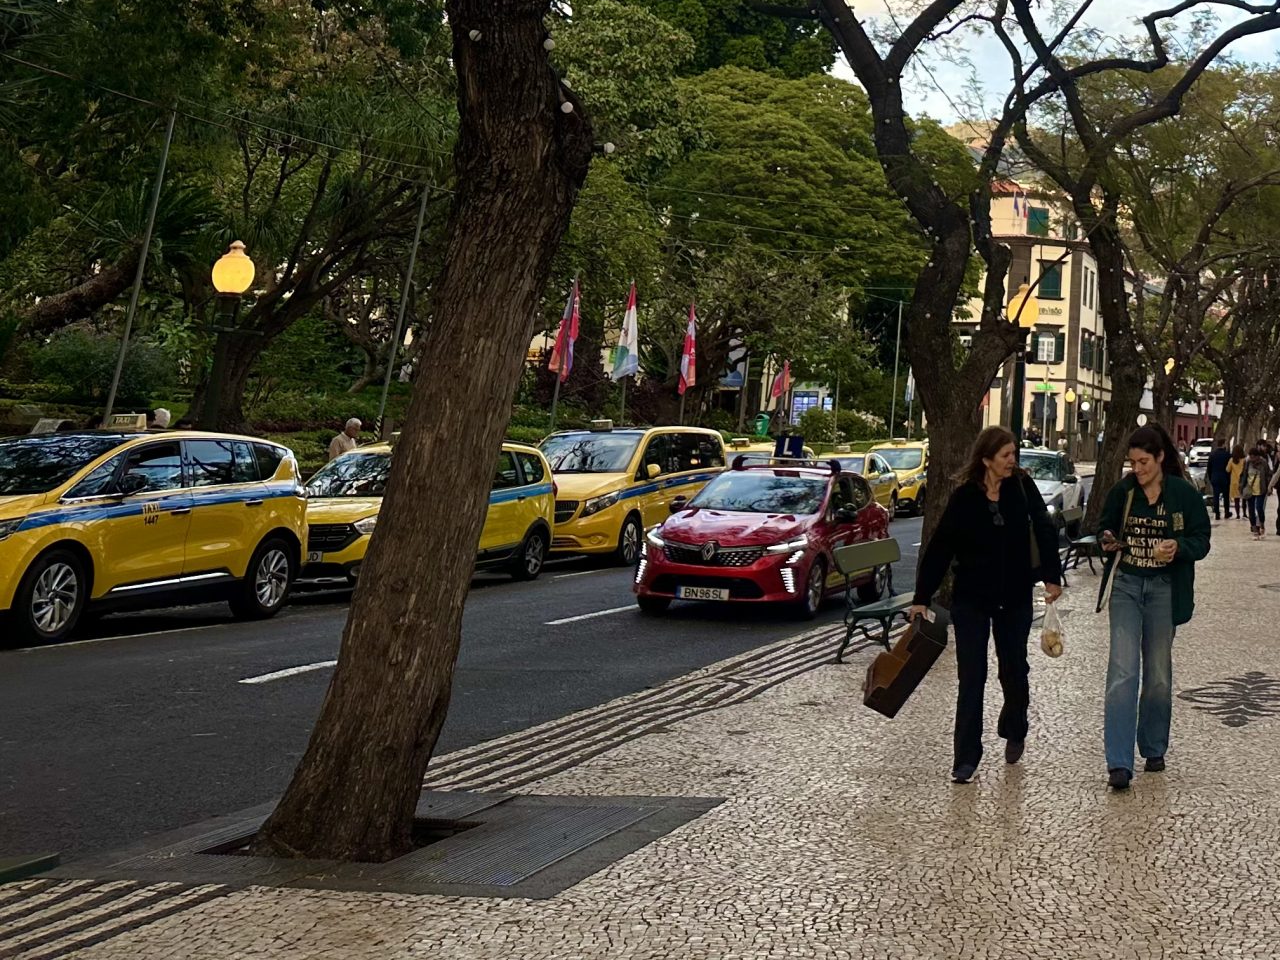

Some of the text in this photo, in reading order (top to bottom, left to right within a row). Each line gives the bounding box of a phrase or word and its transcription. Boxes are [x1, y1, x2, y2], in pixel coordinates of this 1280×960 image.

[783, 437, 793, 456] L
[143, 503, 160, 514] TAXI
[144, 515, 160, 526] 1447
